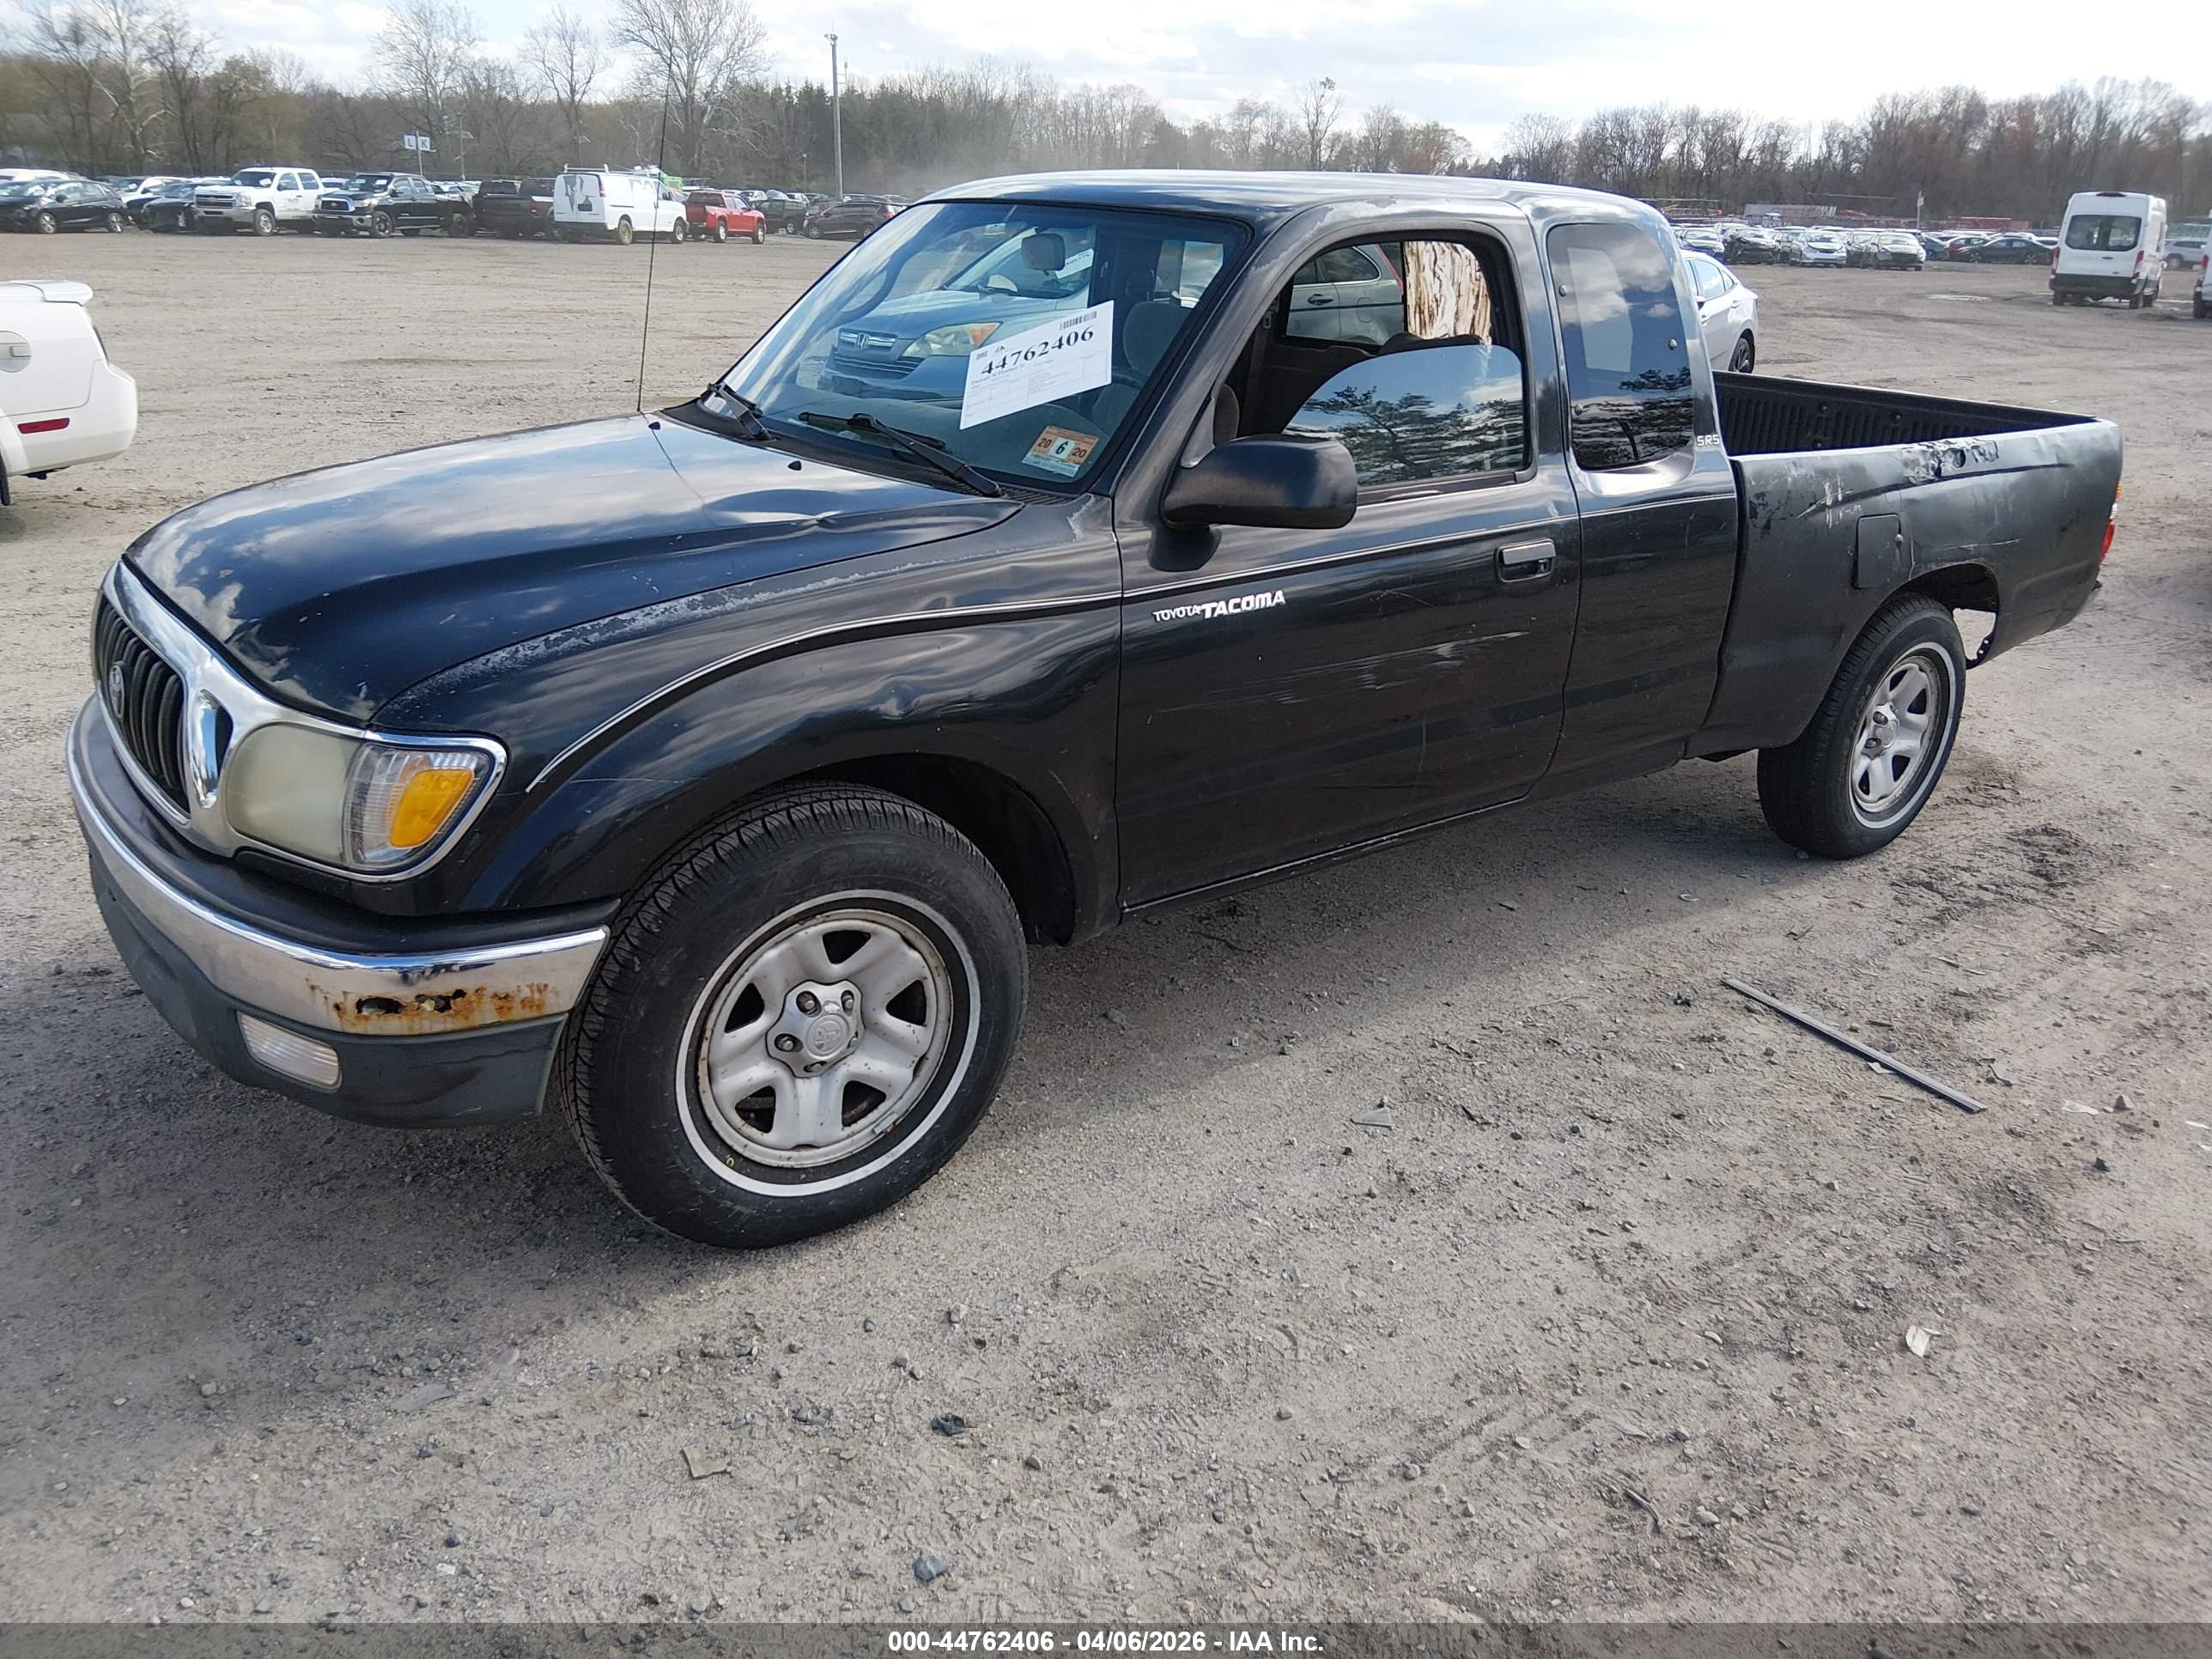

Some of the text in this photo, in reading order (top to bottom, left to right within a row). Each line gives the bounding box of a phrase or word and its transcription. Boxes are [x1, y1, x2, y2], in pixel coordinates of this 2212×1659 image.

[981, 325, 1094, 375] 44762406
[1055, 441, 1069, 455] 6
[1697, 434, 1719, 447] SR5
[1152, 590, 1285, 622] TOYOTA TACOMA
